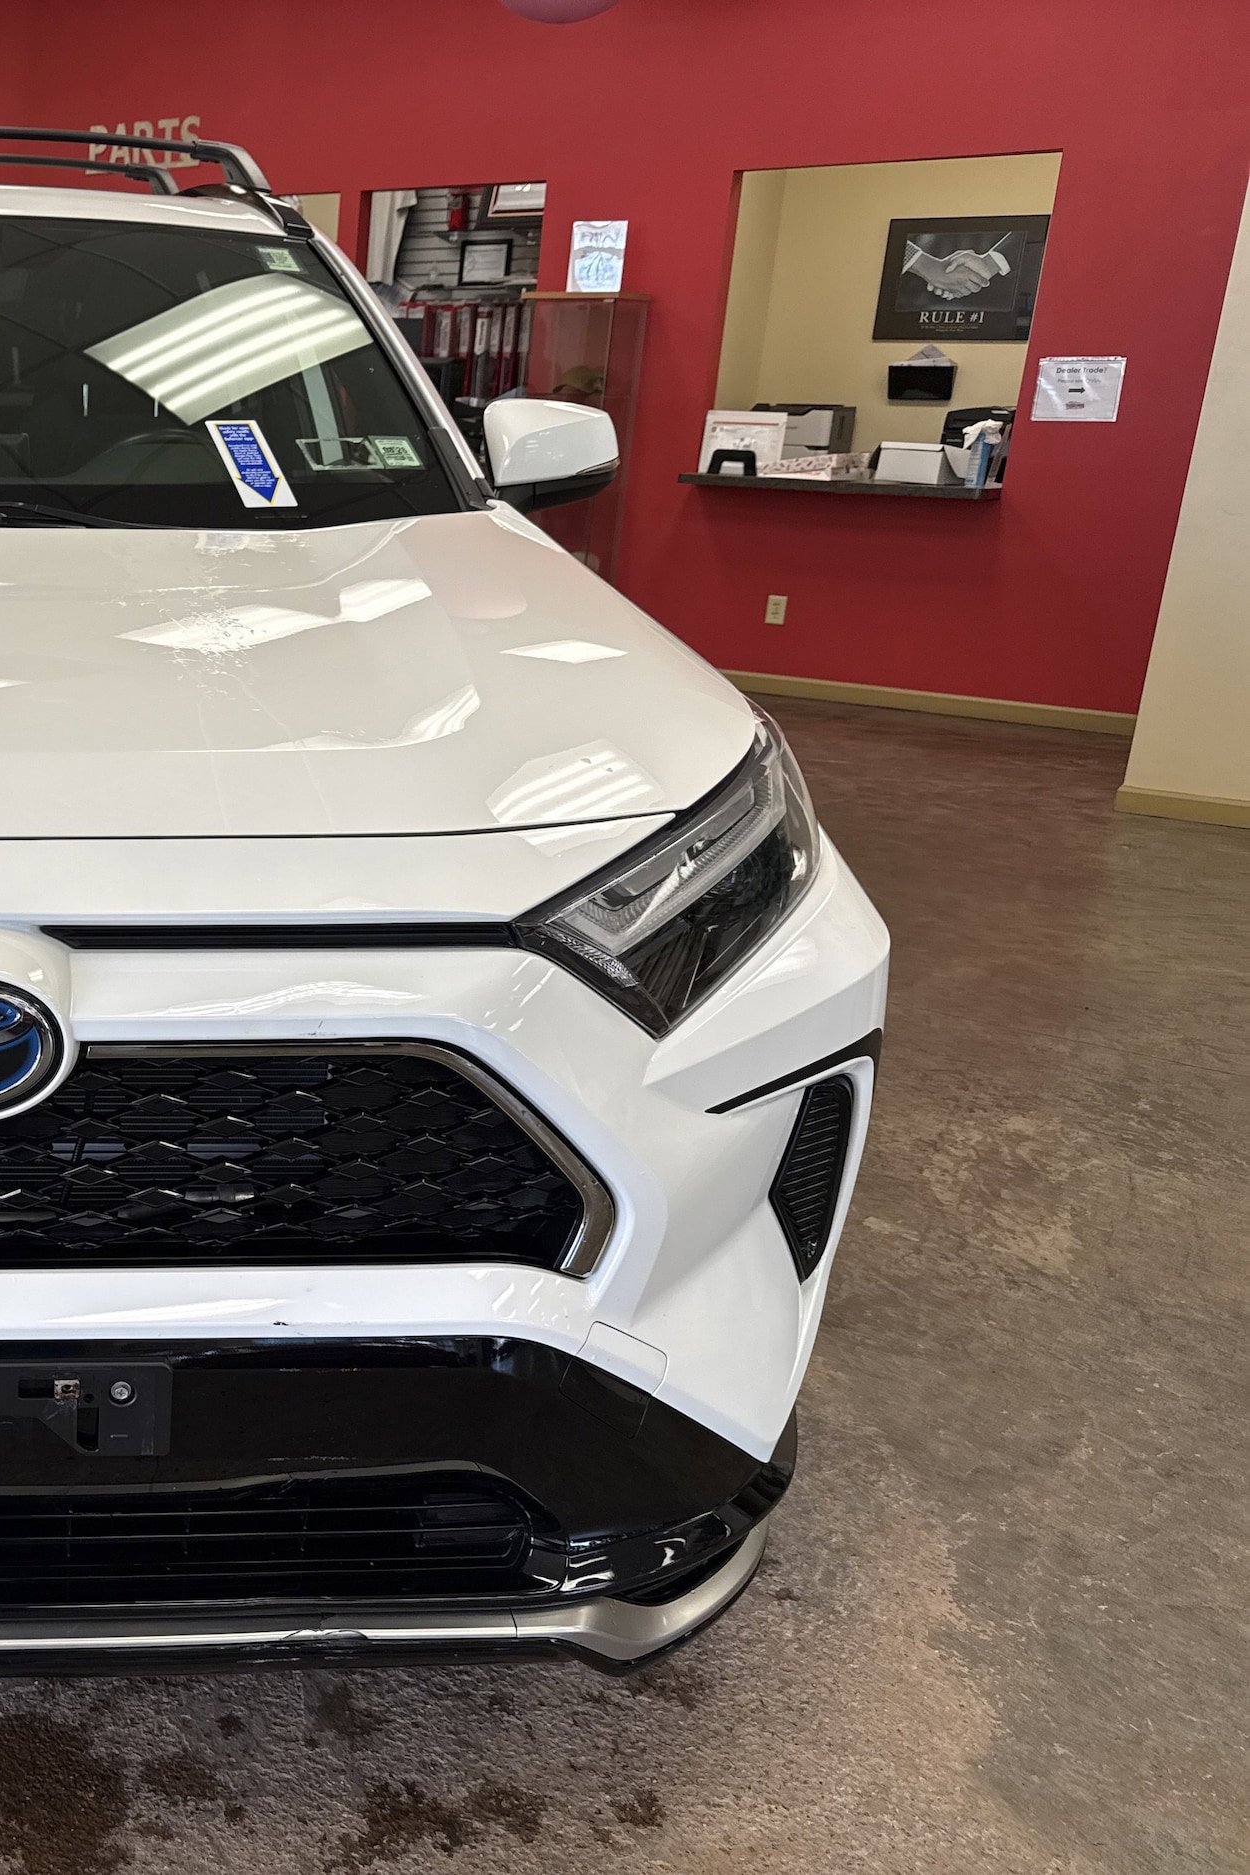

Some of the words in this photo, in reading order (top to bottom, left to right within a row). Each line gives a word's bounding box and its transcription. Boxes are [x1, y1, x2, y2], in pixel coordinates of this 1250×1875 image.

[87, 115, 201, 167] PARTS
[918, 311, 966, 324] RULE
[969, 311, 985, 324] #1
[1056, 366, 1081, 374] Dealer
